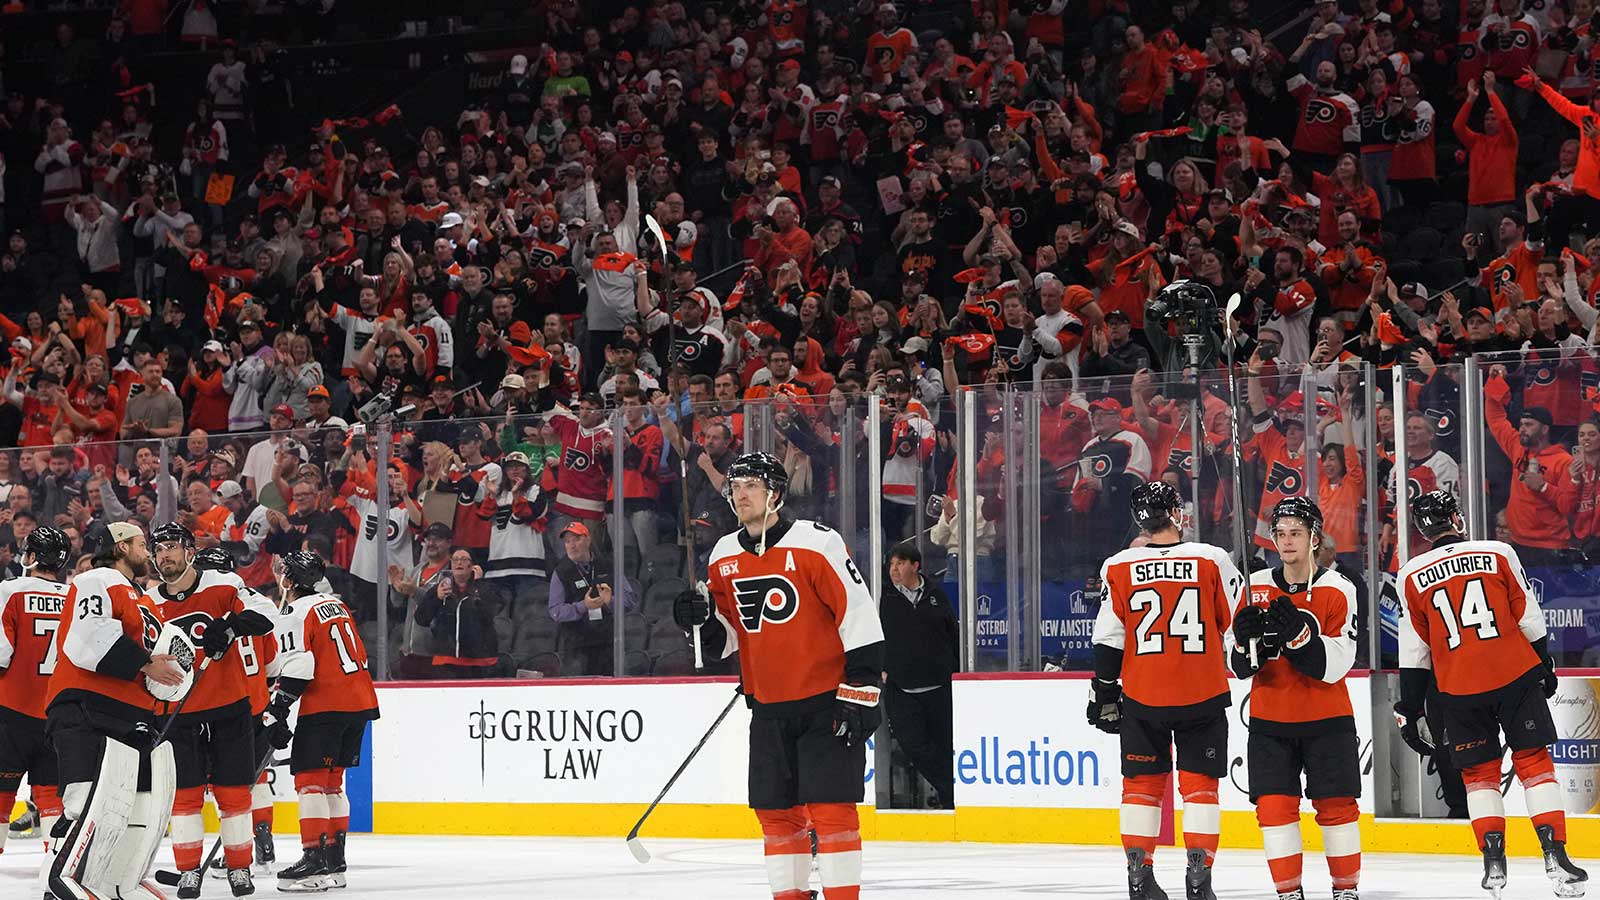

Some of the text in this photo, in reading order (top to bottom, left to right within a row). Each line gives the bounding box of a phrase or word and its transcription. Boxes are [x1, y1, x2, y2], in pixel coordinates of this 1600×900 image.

[718, 559, 740, 577] IBX
[784, 550, 796, 572] A
[1135, 561, 1193, 582] SEELER
[1417, 555, 1493, 588] COUTURIER
[78, 594, 103, 619] 33
[1430, 577, 1501, 651] 14
[1129, 586, 1206, 656] 24
[280, 631, 296, 653] 11
[1061, 640, 1095, 649] VODK
[500, 709, 644, 743] GRUNGO
[543, 748, 603, 780] LAW
[953, 736, 1099, 786] ellation
[1126, 753, 1157, 762] CCM
